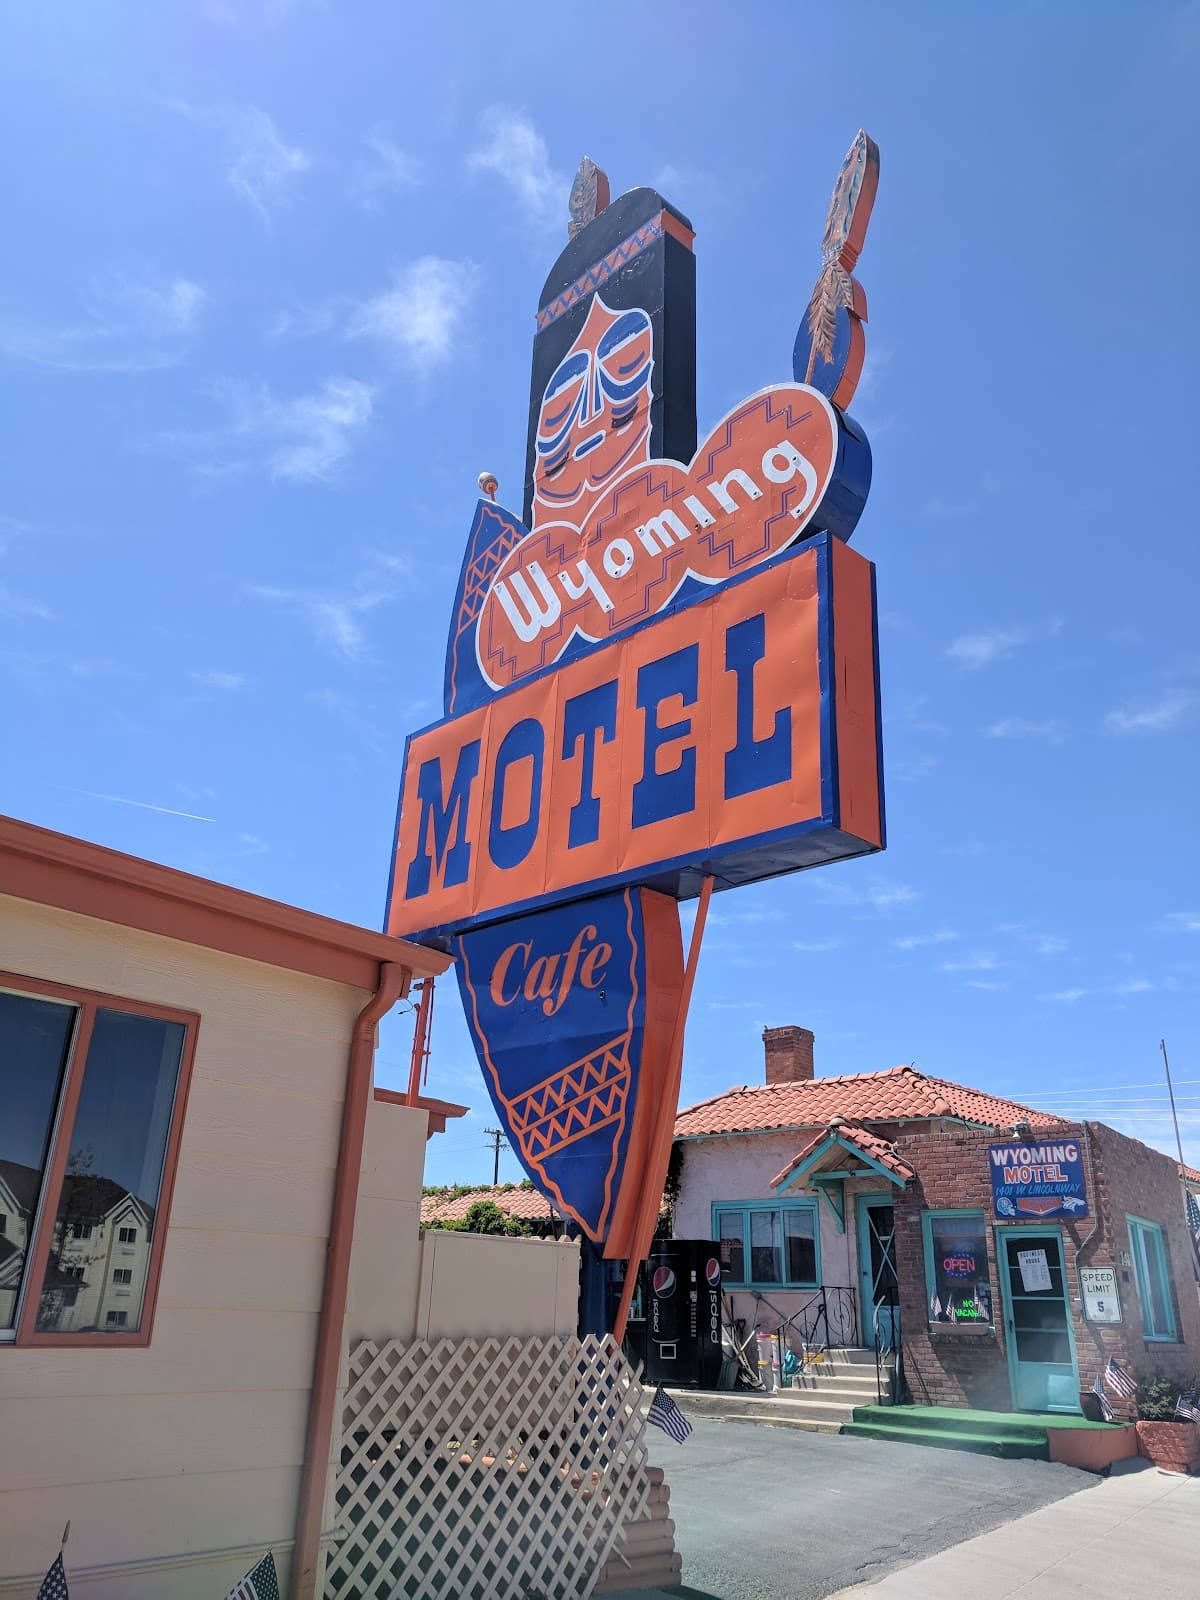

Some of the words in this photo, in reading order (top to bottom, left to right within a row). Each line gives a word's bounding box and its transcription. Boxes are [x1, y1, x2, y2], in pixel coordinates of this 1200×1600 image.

[493, 440, 818, 643] Wyoming
[406, 613, 792, 900] MOTEL
[490, 925, 613, 1017] Cafe
[991, 1145, 1078, 1166] WYOMING
[1003, 1164, 1069, 1185] MOTEL
[995, 1186, 1014, 1196] 1401
[1028, 1183, 1081, 1194] LINCOLNWAY
[943, 1258, 976, 1271] OPEN
[1082, 1273, 1113, 1282] SPEED
[1087, 1284, 1110, 1293] LIMIT
[708, 1290, 720, 1344] pepsi
[1097, 1301, 1105, 1312] 5
